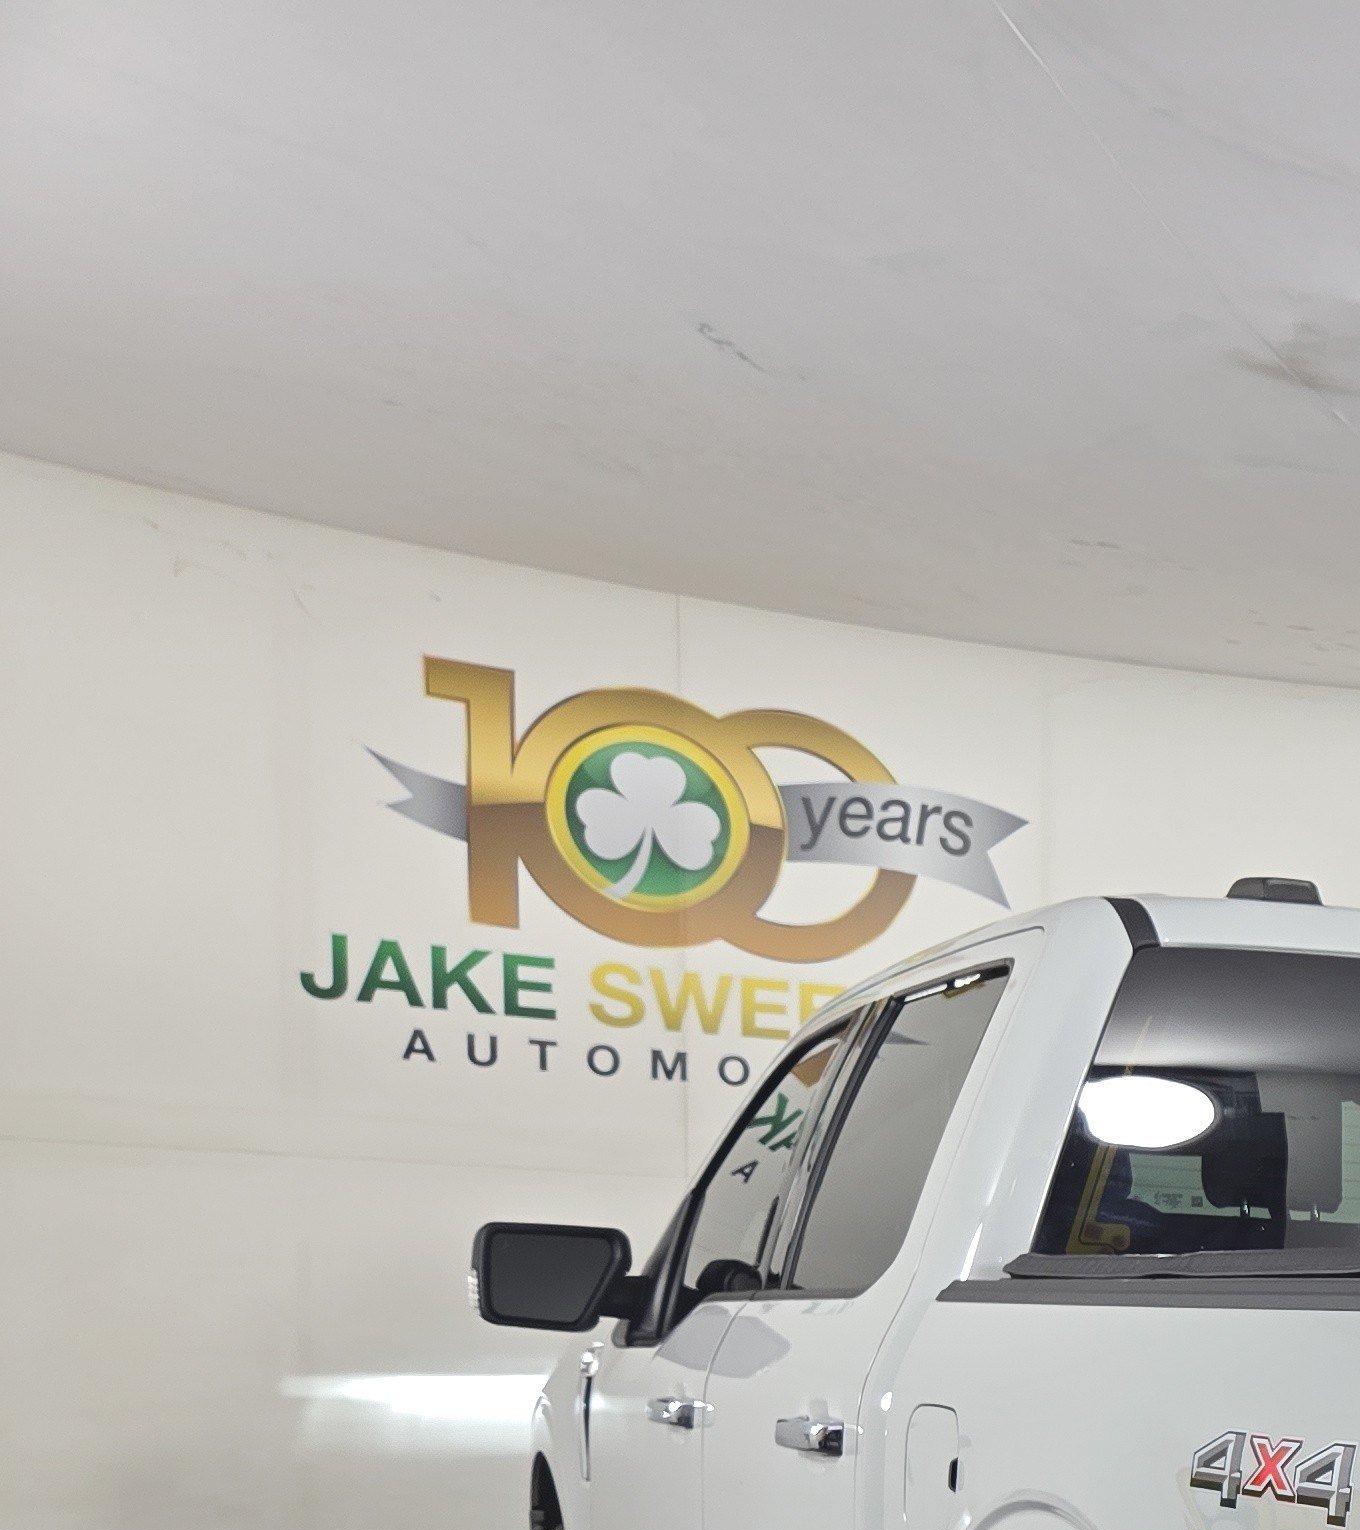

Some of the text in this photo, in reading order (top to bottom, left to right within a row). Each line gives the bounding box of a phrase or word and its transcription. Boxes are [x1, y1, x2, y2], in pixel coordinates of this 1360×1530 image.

[421, 654, 974, 963] 100 years
[299, 932, 557, 1020] JAKE
